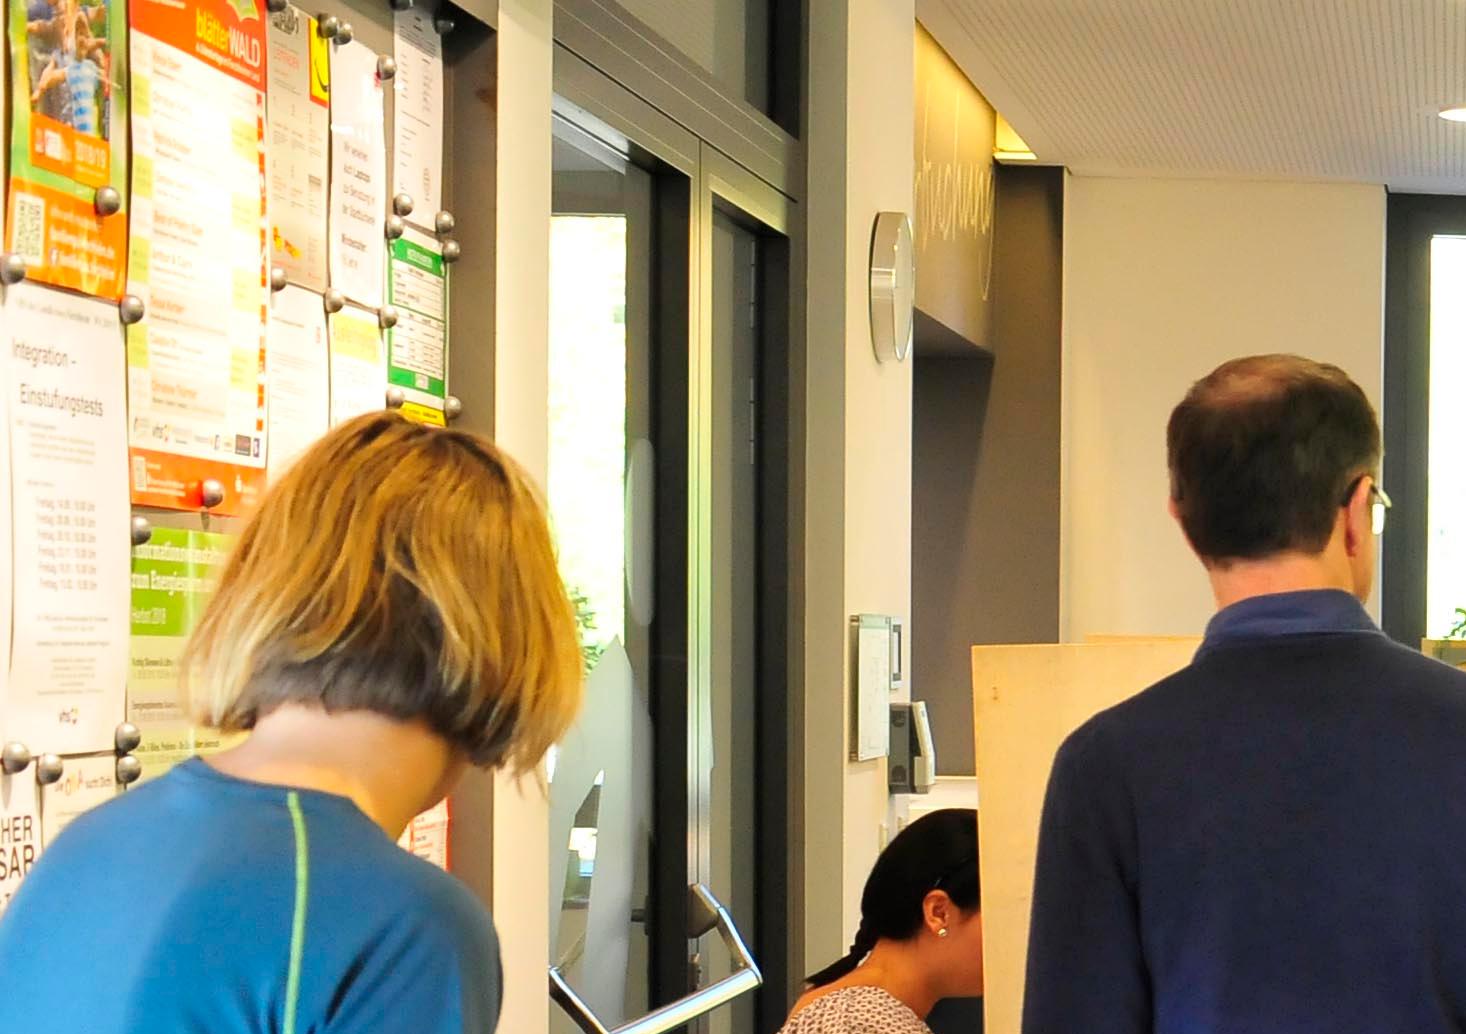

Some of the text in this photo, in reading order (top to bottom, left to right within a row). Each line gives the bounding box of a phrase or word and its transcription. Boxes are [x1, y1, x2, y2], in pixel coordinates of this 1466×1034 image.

[12, 336, 68, 368] Integration
[20, 382, 104, 418] Einstufungstests
[1, 815, 33, 843] HER
